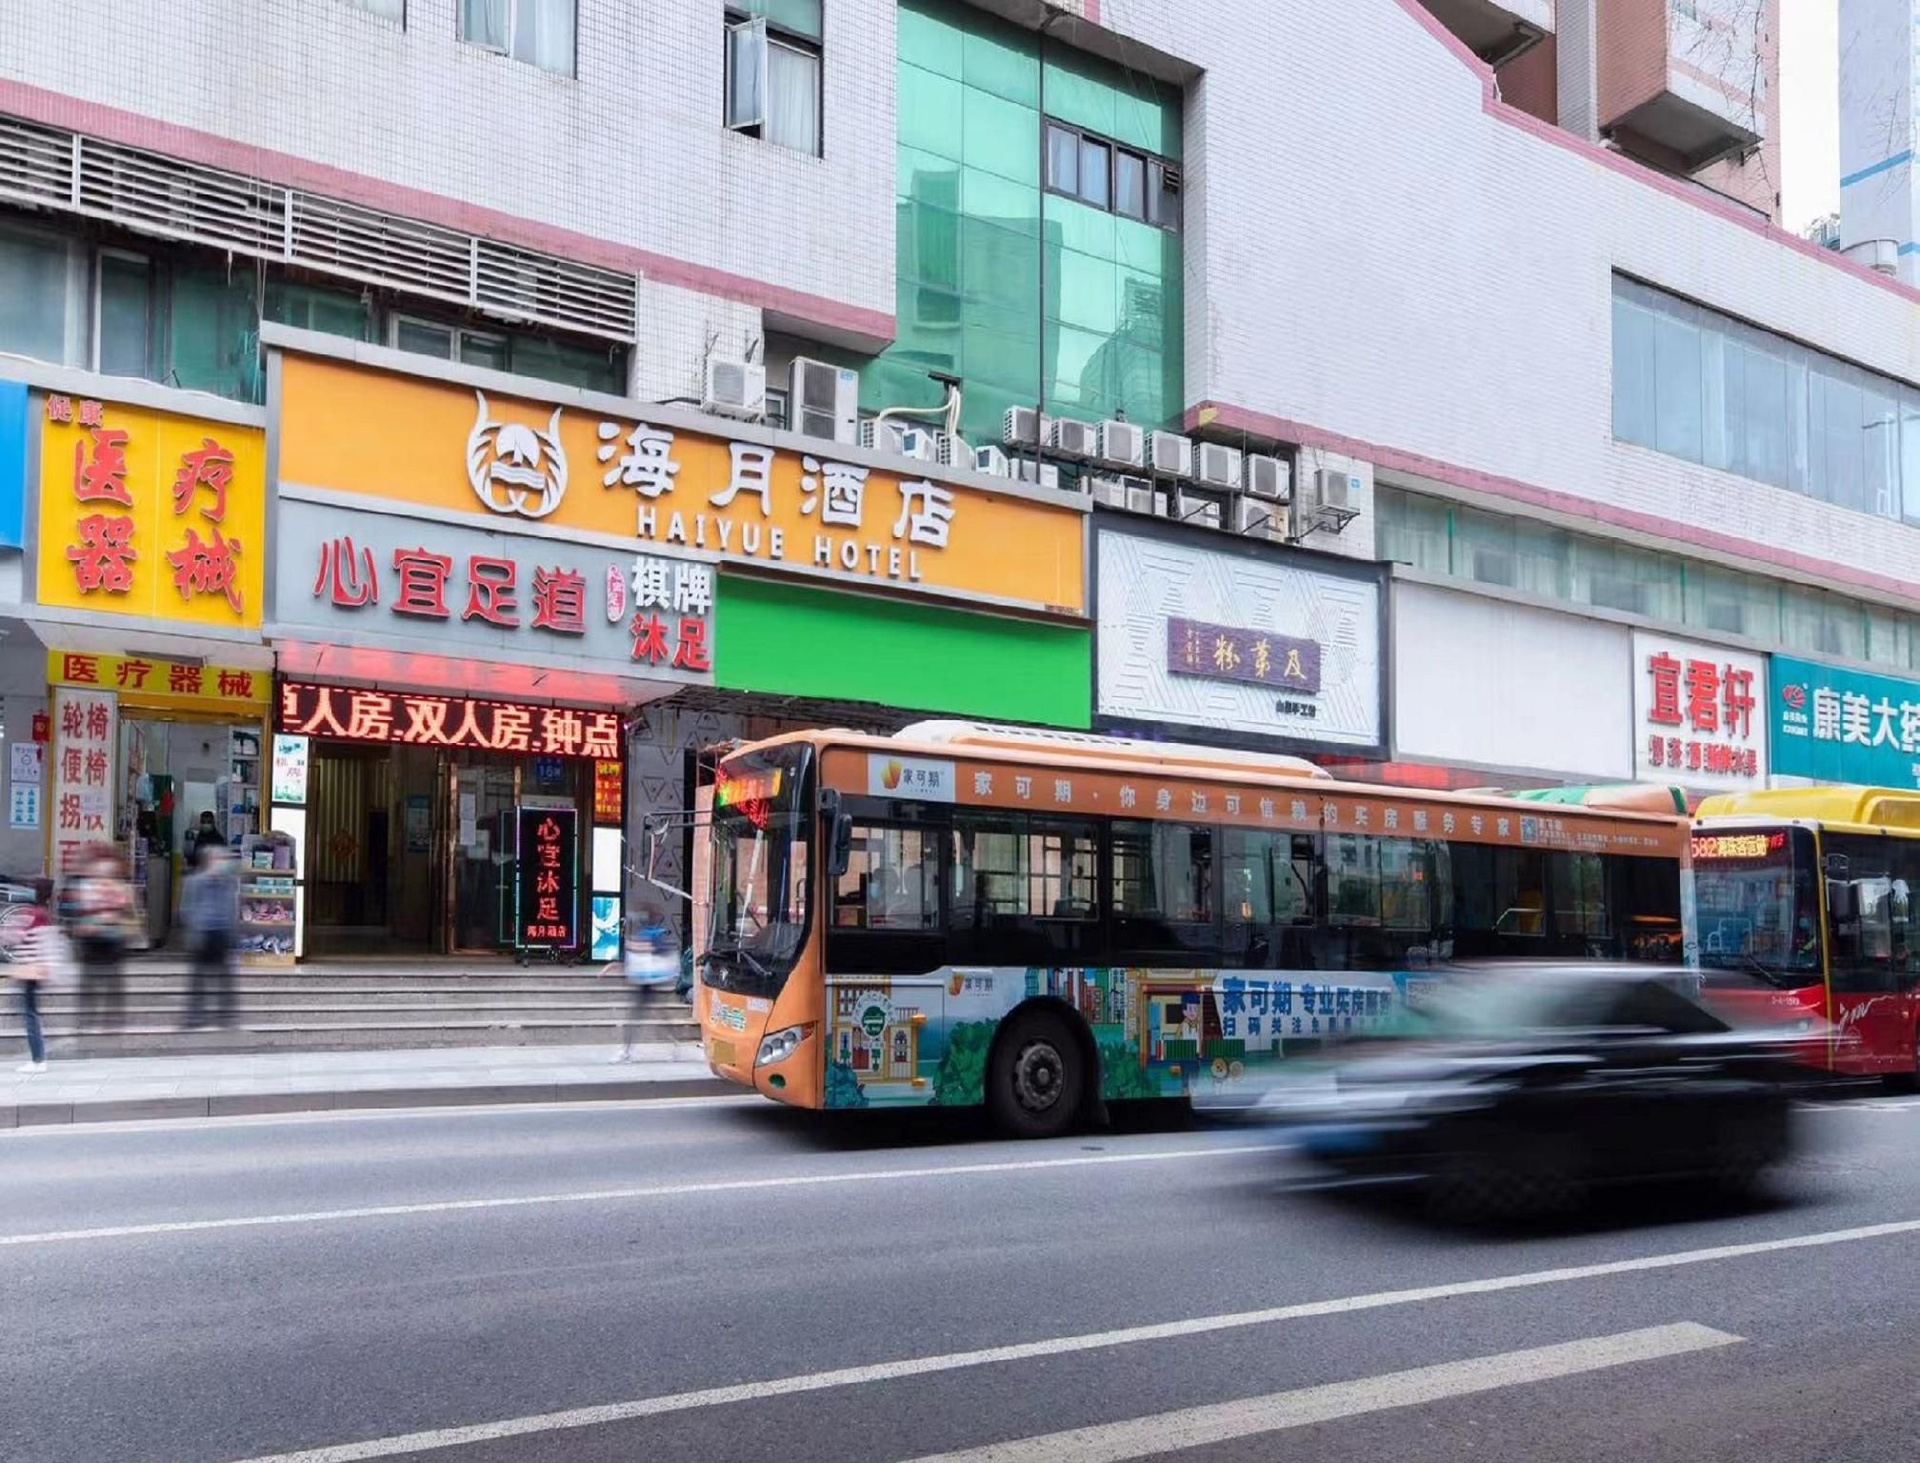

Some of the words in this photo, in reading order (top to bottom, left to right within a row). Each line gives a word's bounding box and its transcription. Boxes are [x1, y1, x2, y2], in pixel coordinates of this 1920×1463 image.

[74, 429, 236, 522] 医疗
[598, 422, 954, 548] 海月酒店
[66, 513, 244, 615] 器械
[637, 506, 784, 560] HAIYUE
[814, 537, 923, 581] HOTEL
[312, 536, 587, 634] 心宜足道
[631, 556, 712, 614] 棋牌
[631, 611, 711, 671] 沐足
[63, 654, 253, 698] 医疗器械
[1648, 651, 1756, 738] 宜君轩
[62, 701, 108, 742] 轮椅
[1812, 686, 1920, 753] 康美大药
[61, 747, 107, 787] 便椅
[903, 769, 940, 787] 家可期
[537, 817, 561, 921] 心宜沐足
[1691, 837, 1717, 857] 582
[1223, 976, 1292, 1015] 家可期
